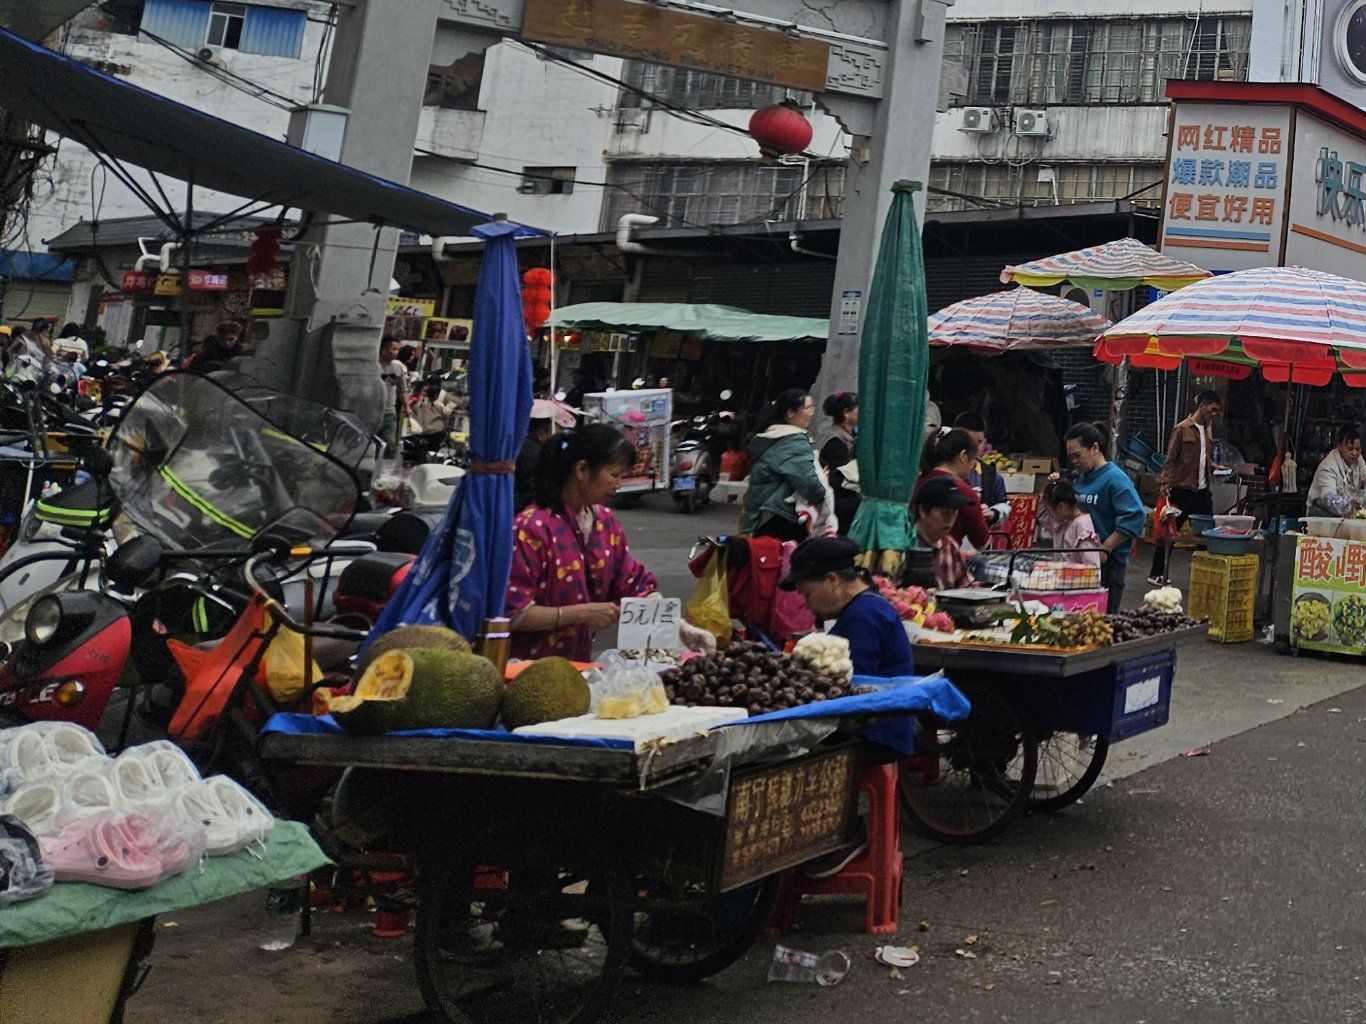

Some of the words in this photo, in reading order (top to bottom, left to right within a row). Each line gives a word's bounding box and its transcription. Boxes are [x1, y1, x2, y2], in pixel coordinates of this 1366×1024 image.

[1177, 125, 1282, 154] 网红精品
[1171, 158, 1278, 189] 爆款潮品
[1168, 192, 1276, 225] 便宜好用
